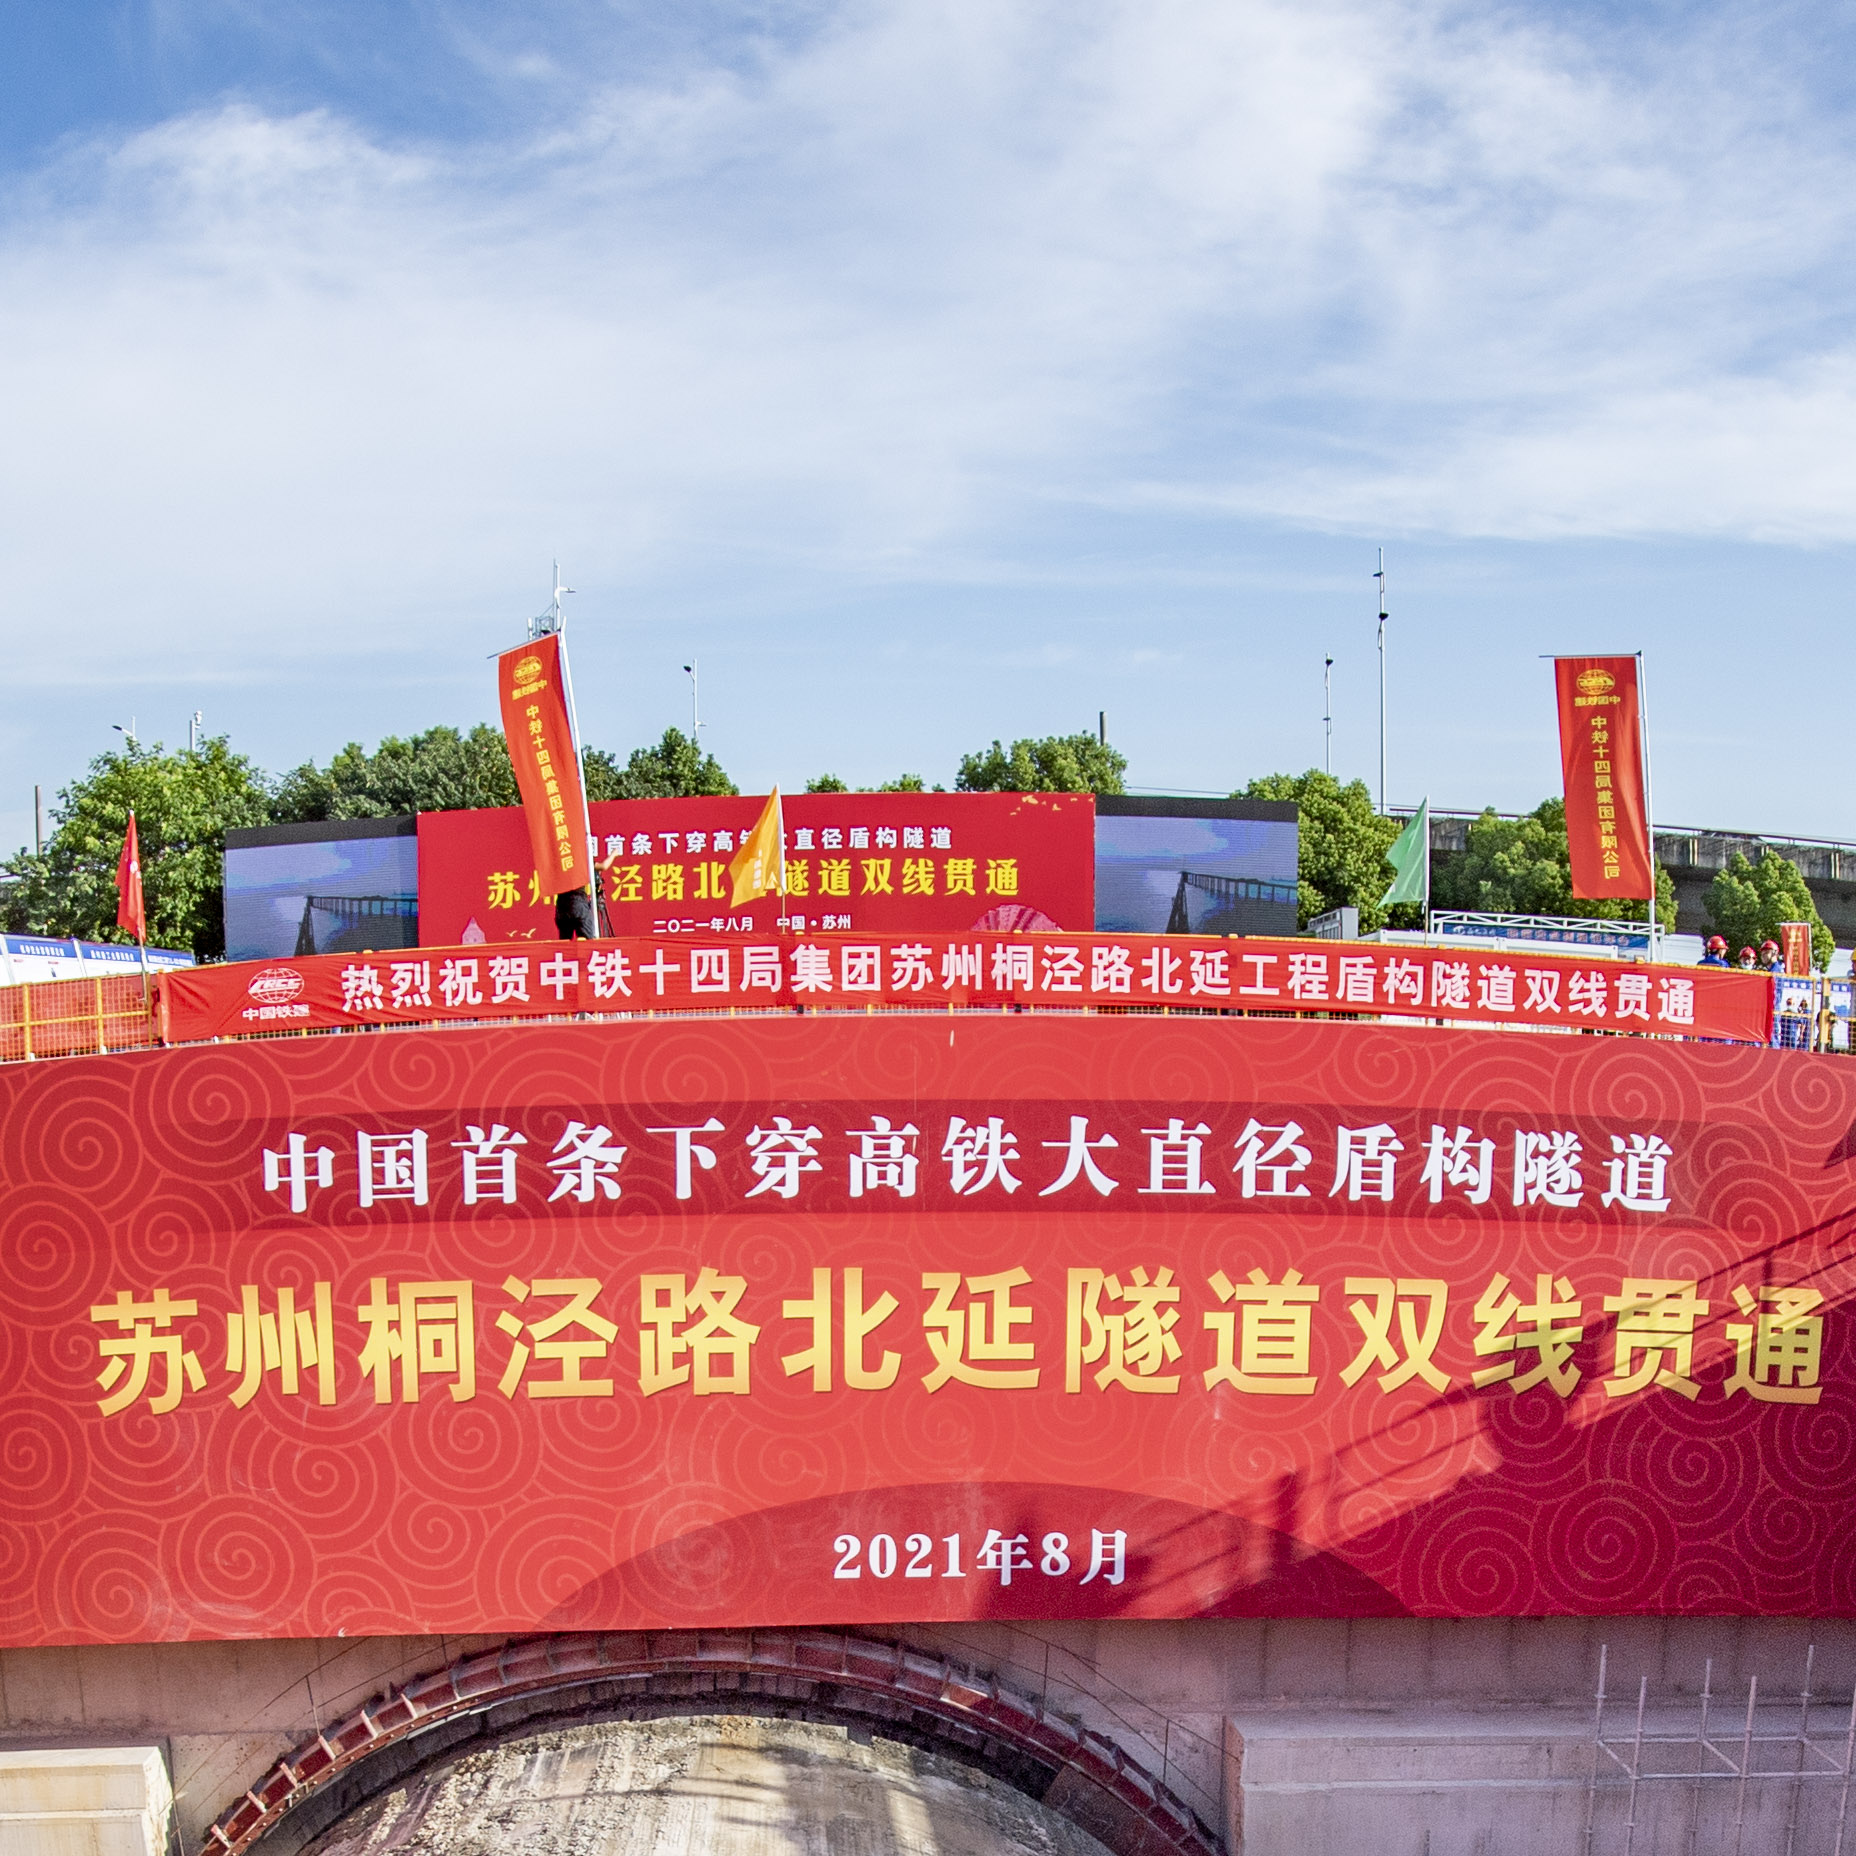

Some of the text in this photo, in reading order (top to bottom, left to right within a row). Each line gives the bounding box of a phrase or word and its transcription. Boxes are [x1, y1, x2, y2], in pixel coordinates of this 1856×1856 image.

[591, 827, 951, 857] 首条下穿高直径盾构隧道
[488, 857, 1019, 909] 苏泾路北隧道双线贯通
[242, 1004, 310, 1021] 中国铁建
[342, 944, 1696, 1025] 热烈祝贺中铁十四局集团苏州桐泾路北延工程盾构隧道双线贯通
[263, 1116, 1673, 1213] 中国首条下穿高铁大直径盾构隧道
[90, 1265, 1826, 1417] 苏州桐泾路北延隧道双线贯通
[833, 1528, 1129, 1586] 2021年8月
